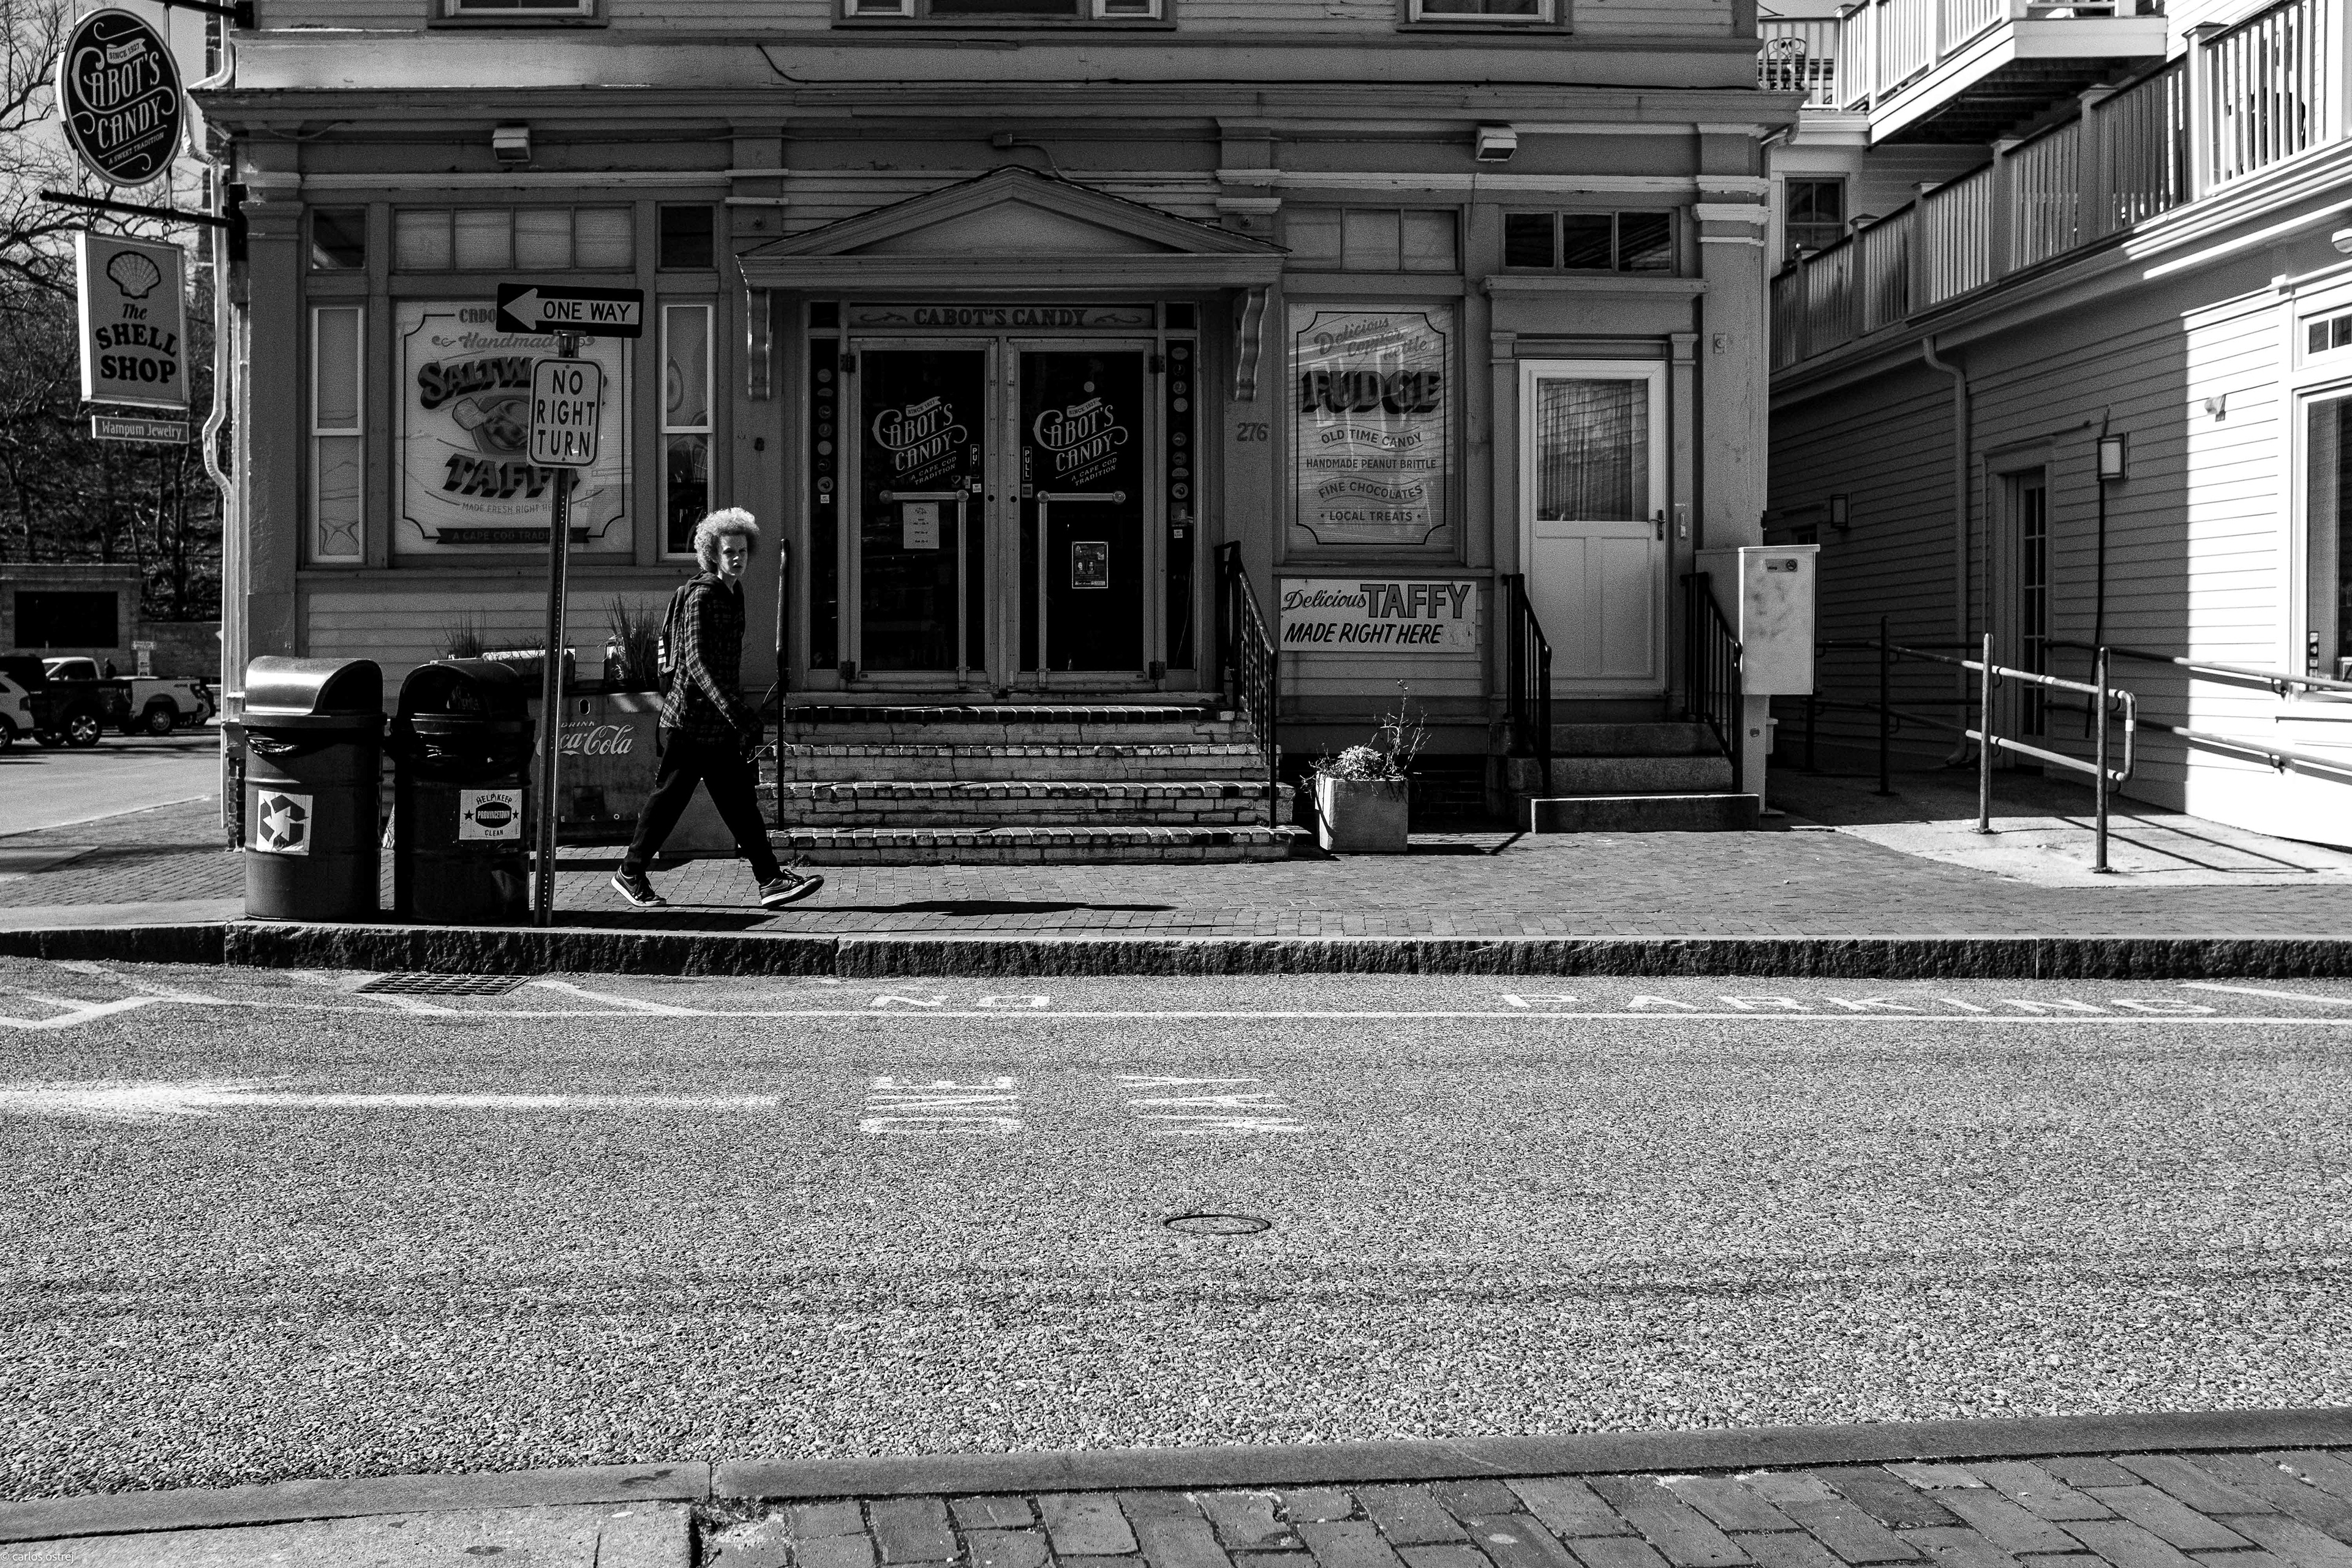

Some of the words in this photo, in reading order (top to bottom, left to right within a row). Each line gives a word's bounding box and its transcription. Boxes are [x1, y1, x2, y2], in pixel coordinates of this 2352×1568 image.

[109, 50, 127, 59] SINCE
[71, 47, 160, 112] CABOT'S
[97, 96, 161, 149] CANDY
[134, 132, 164, 152] TRADITION
[123, 304, 148, 320] The
[459, 309, 496, 323] CABO
[543, 301, 582, 320] ONE
[590, 303, 631, 322] WAY
[914, 308, 1007, 326] CABOT'S
[1012, 309, 1088, 326] CANDY
[96, 323, 176, 357] SHELL
[459, 332, 559, 349] Handmad
[1314, 318, 1389, 355] Delicious
[100, 355, 176, 383] SHOP
[552, 370, 583, 395] NO
[1301, 370, 1441, 415] FUDGE
[537, 399, 595, 426] RIGHT
[102, 421, 145, 437] Wampum
[147, 423, 182, 441] Jewelry
[872, 404, 953, 449] CABOT'S
[1033, 405, 1114, 451] CABOT'S
[1237, 423, 1268, 441] 276
[538, 430, 590, 456] TURN
[1321, 430, 1344, 443] OLD
[1349, 429, 1379, 443] TIME
[1382, 432, 1421, 447] CANDY
[895, 432, 952, 471] CANDY
[1056, 432, 1113, 472] CANDY
[914, 463, 956, 485] TRADITION
[919, 464, 939, 477] CAPE
[941, 456, 957, 467] COD
[1079, 465, 1099, 477] CAPE
[1102, 458, 1117, 467] COD
[1306, 459, 1358, 468] HANDMADE
[1362, 459, 1397, 469] PEANUT
[1400, 459, 1436, 469] BRITTLE
[442, 453, 581, 498] TAFF
[1075, 464, 1116, 486] TRADITION
[1319, 482, 1346, 499] FINE
[1349, 481, 1423, 499] CHOCOLATES
[462, 503, 484, 512] MADE
[487, 505, 513, 514] FRESH
[516, 504, 538, 513] RIGHT
[1330, 511, 1365, 521] LOCAL
[1370, 512, 1412, 521] TREATS
[453, 532, 459, 540] A
[462, 531, 489, 540] CAPE
[493, 531, 514, 540] COD
[1281, 589, 1367, 611] Delicious
[1360, 584, 1471, 619] TAFFY
[1284, 623, 1338, 643] MADE
[1338, 624, 1397, 644] RIGHT
[1395, 624, 1444, 644] HERE
[536, 724, 635, 756] ca-Cola
[476, 794, 495, 805] HELP
[497, 794, 513, 804] KEEP
[478, 810, 511, 819] PROVINCETOWN
[870, 995, 1050, 1008] NO
[1502, 993, 2218, 1014] PARKING
